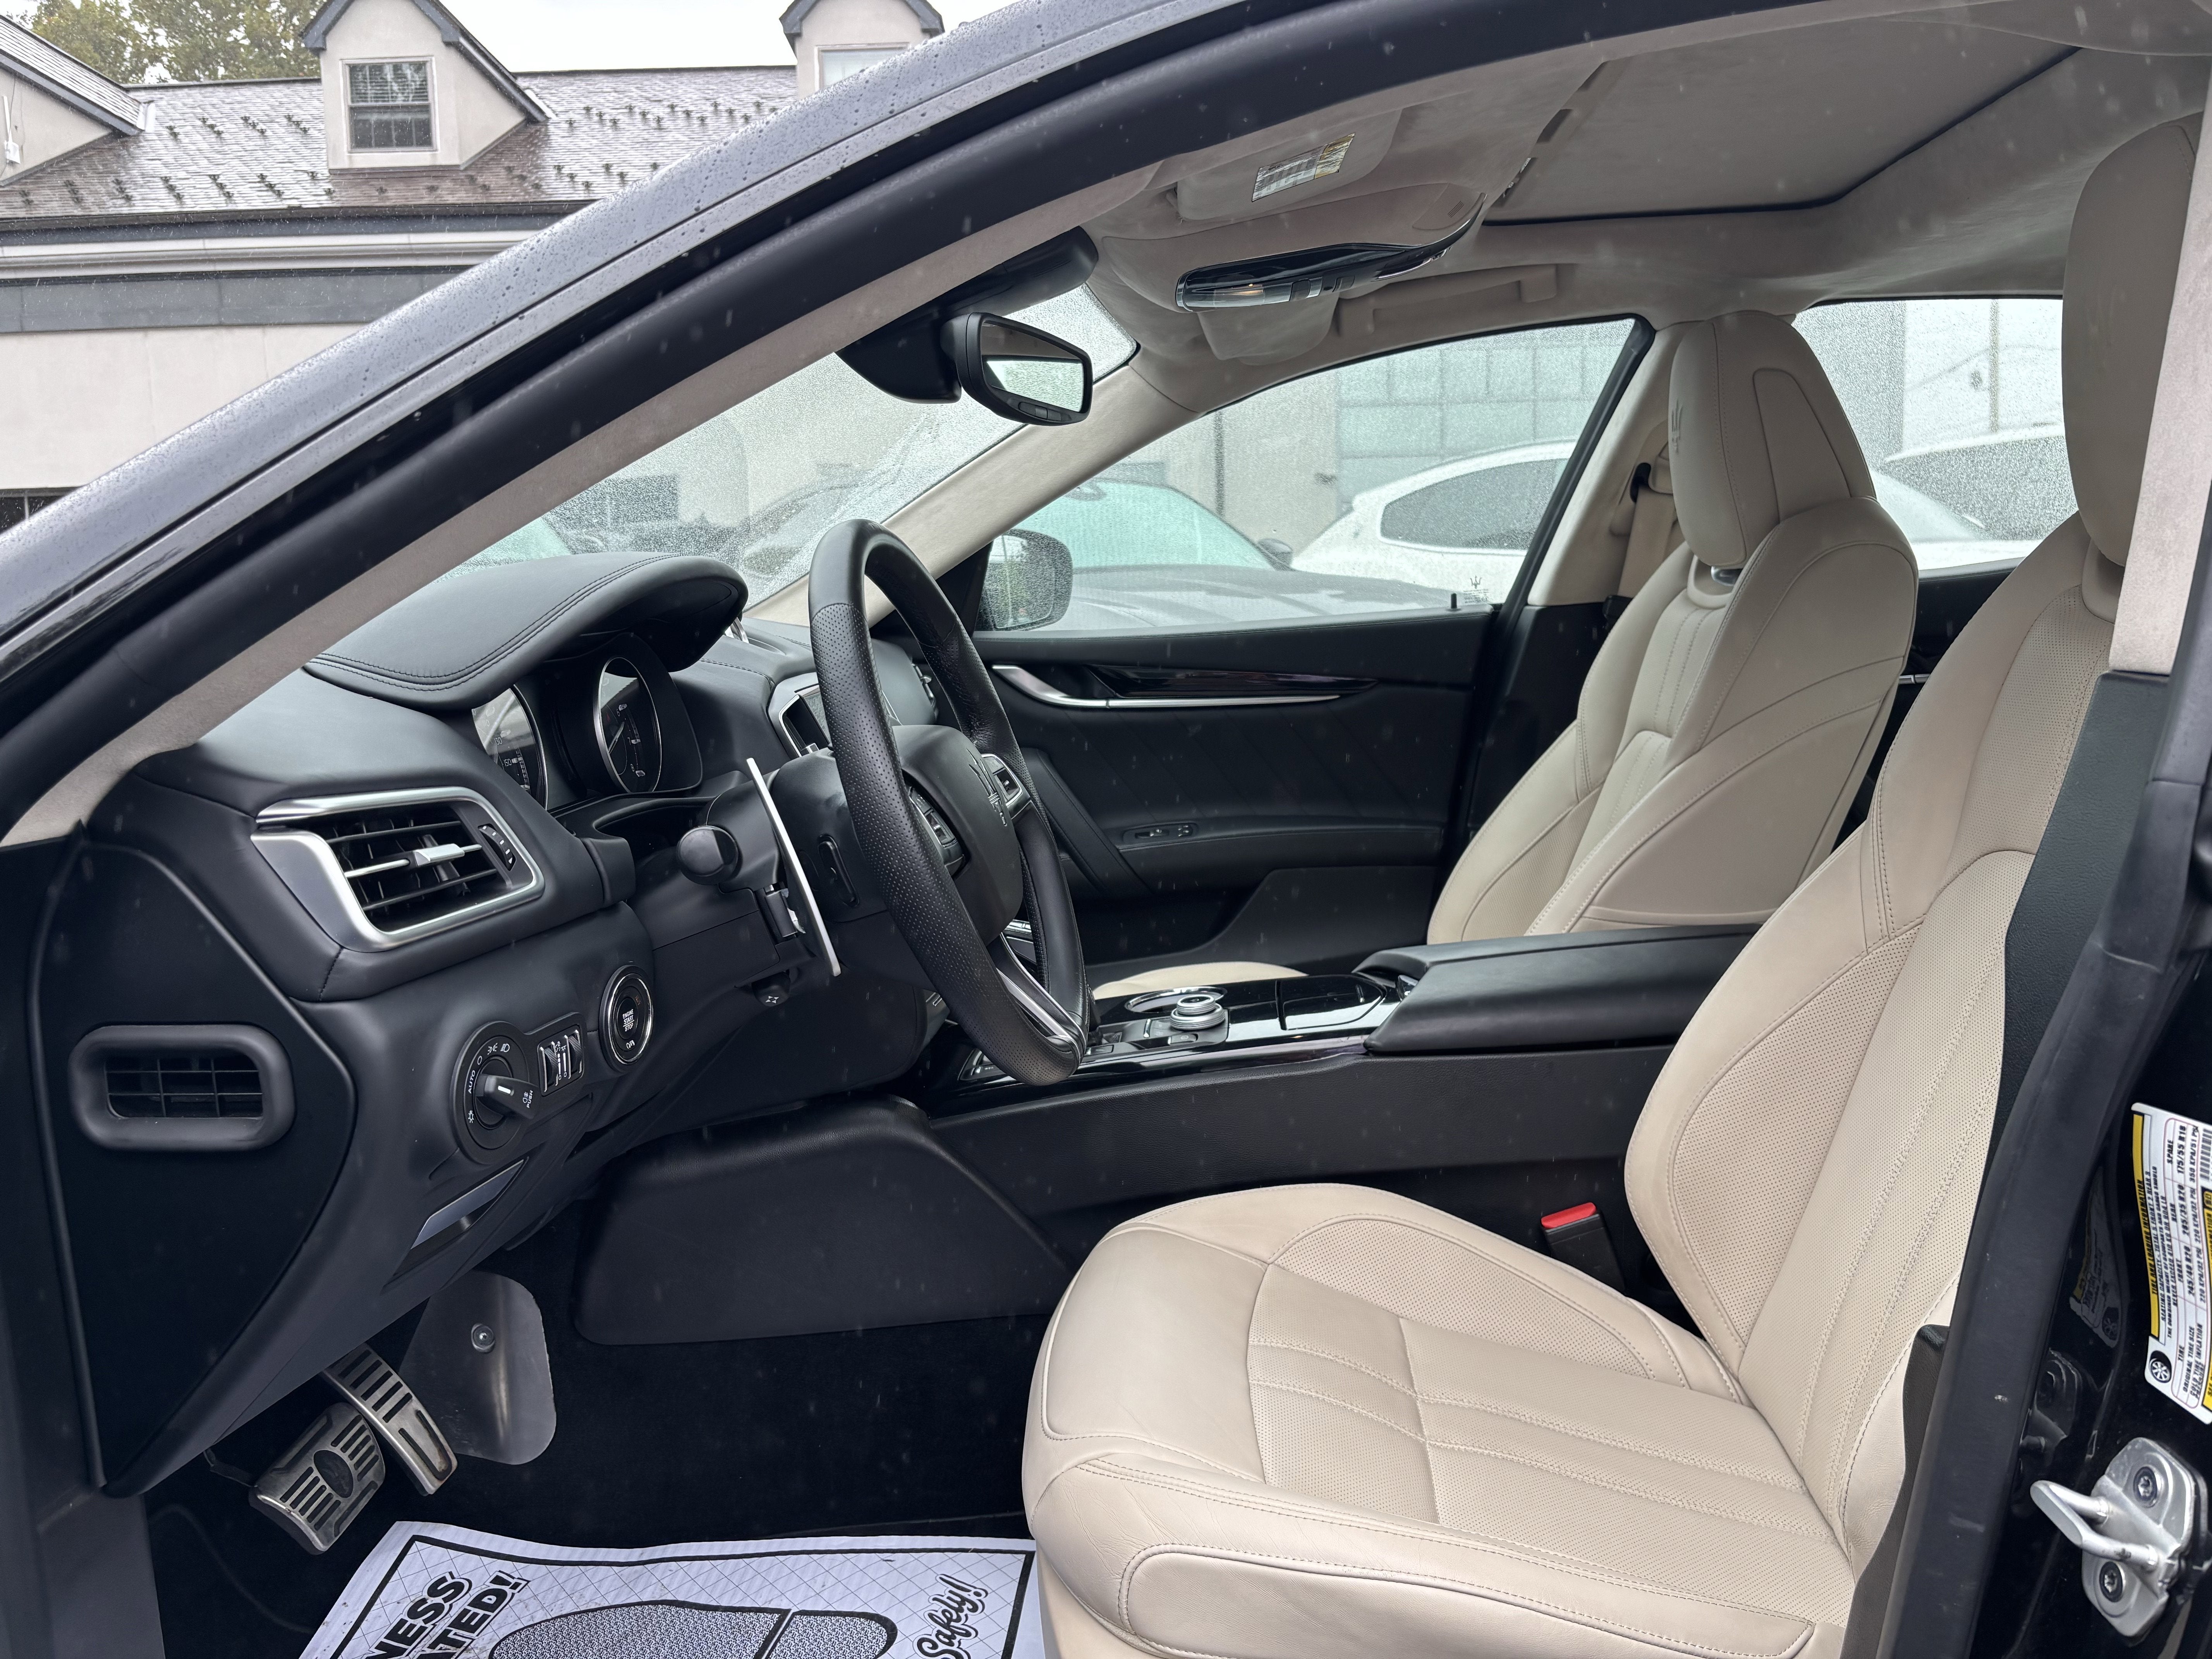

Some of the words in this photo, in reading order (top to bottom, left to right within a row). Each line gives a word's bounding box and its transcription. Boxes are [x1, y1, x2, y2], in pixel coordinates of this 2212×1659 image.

[494, 737, 502, 745] 130
[503, 758, 512, 766] 150
[623, 1009, 634, 1019] ENGINE
[624, 1015, 634, 1025] START
[625, 1022, 634, 1032] STOP
[2177, 1184, 2185, 1202] R20
[2137, 1180, 2149, 1229] INFORMATION
[2178, 1202, 2190, 1237] 285/35
[2144, 1231, 2154, 1261] LOADING
[2183, 1245, 2191, 1263] R20
[2156, 1258, 2164, 1291] CAPACITY
[2186, 1264, 2195, 1296] 245/40
[2183, 1360, 2192, 1393] ORIGINAL
[2190, 1377, 2199, 1396] COLD
